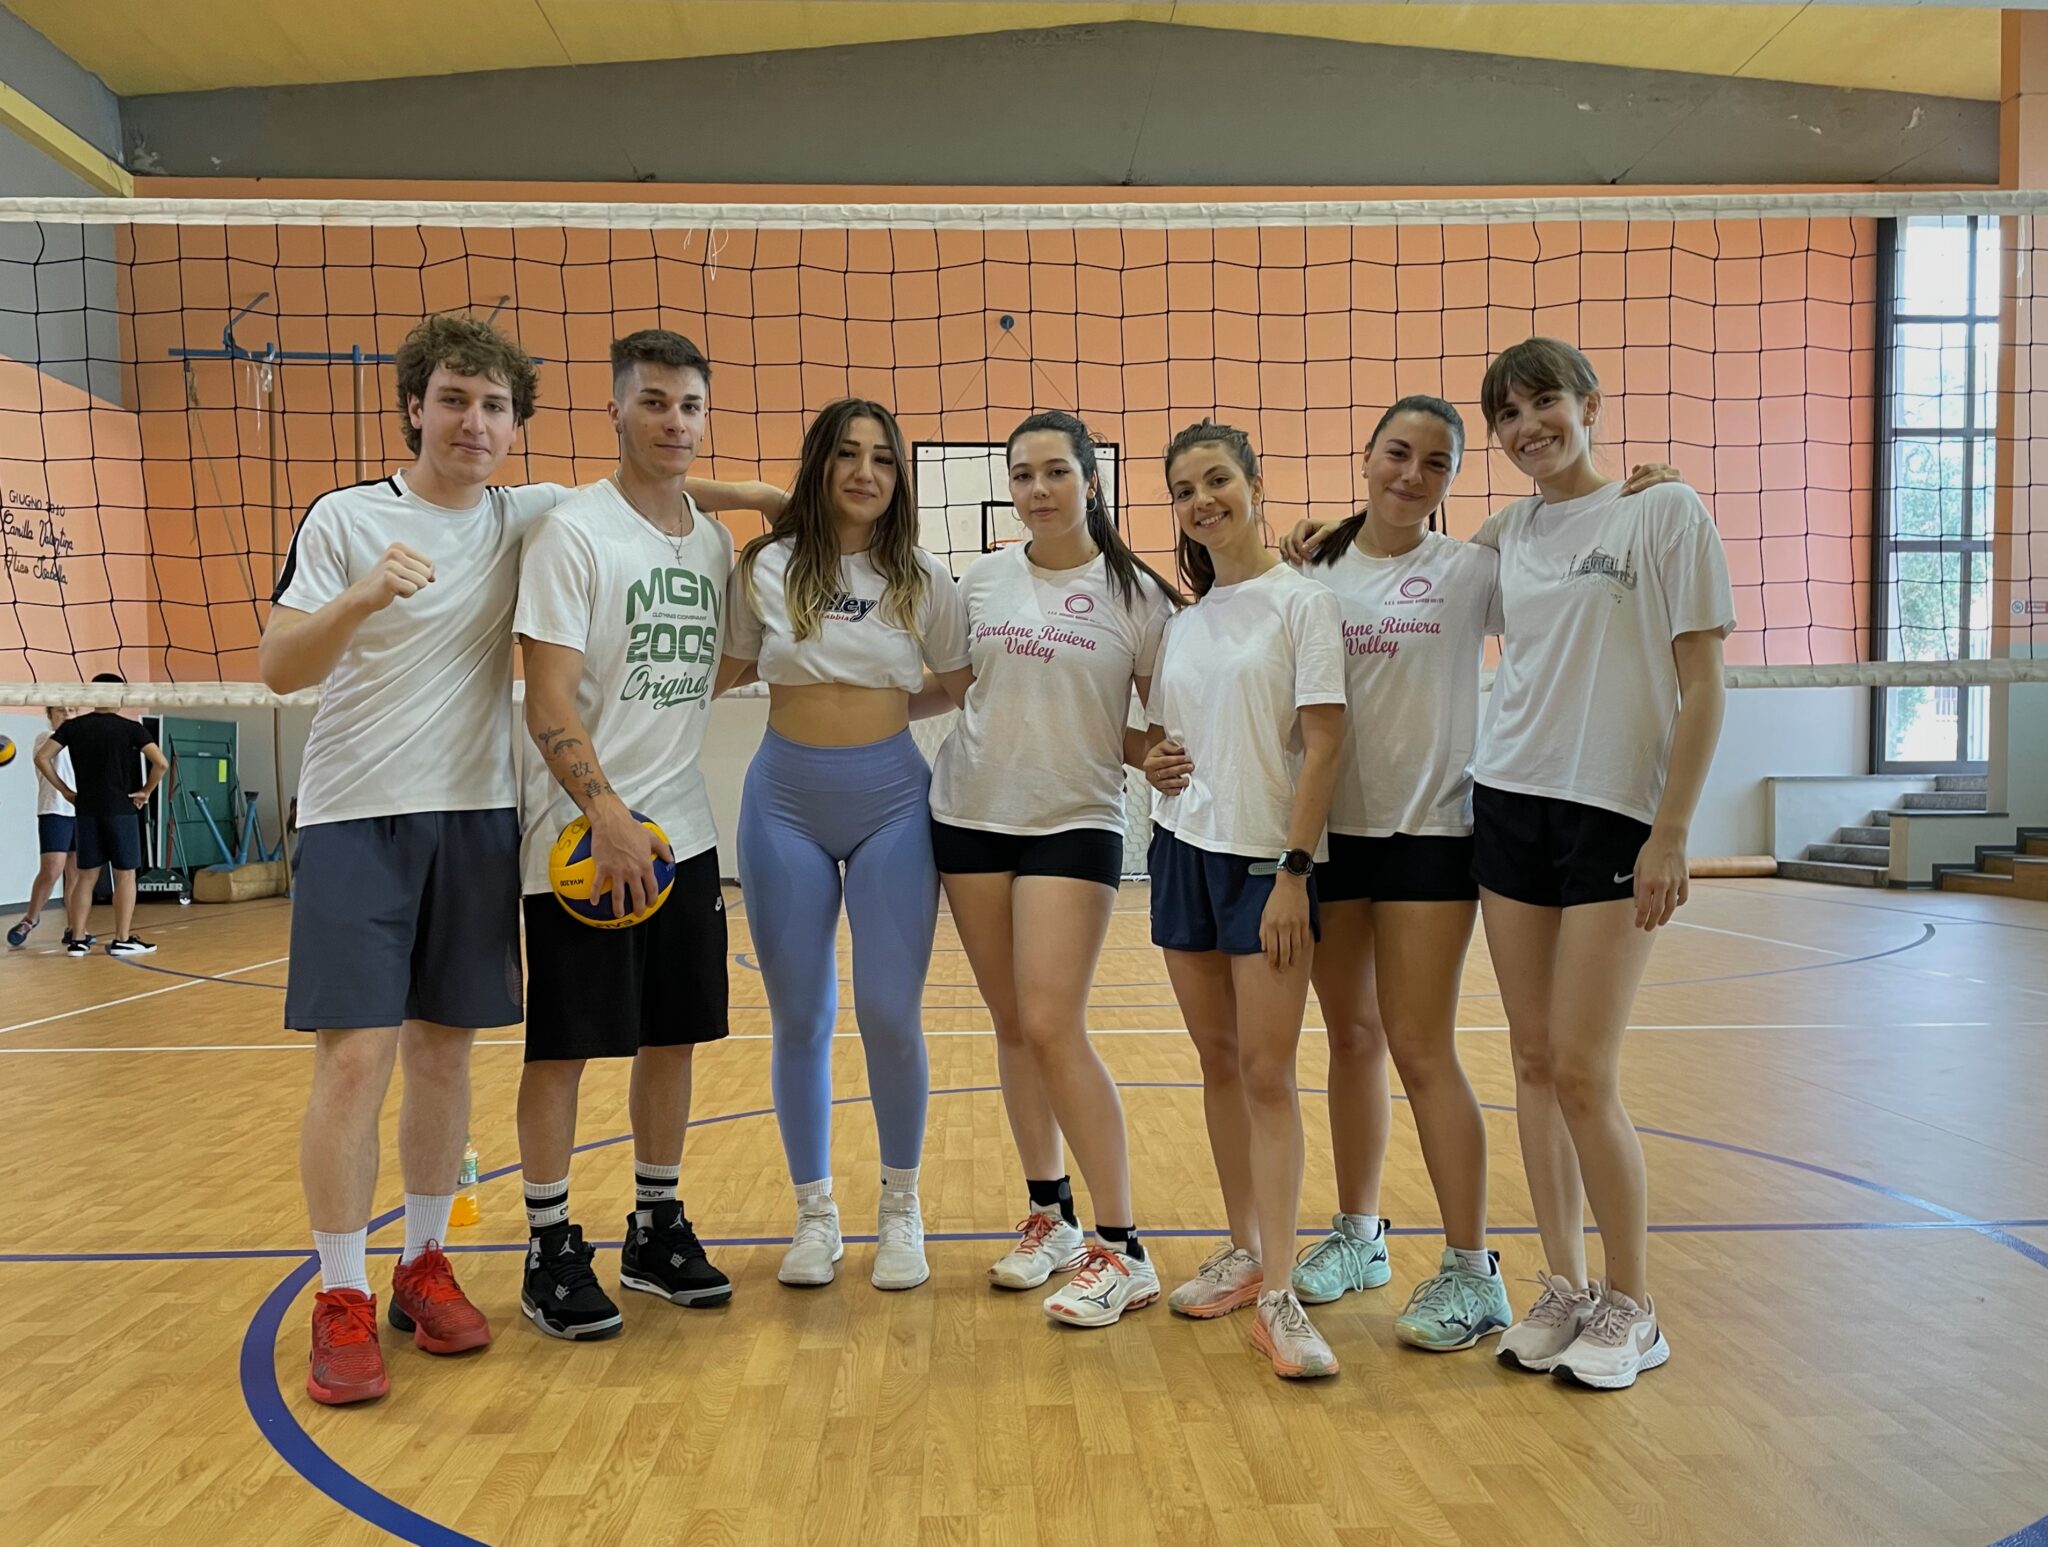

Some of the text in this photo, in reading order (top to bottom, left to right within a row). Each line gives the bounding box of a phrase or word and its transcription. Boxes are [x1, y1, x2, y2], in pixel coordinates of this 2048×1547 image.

[9, 490, 42, 508] GIUGNO
[976, 620, 1097, 651] Gardone Riviera
[1379, 616, 1441, 635] Riviera
[1005, 636, 1055, 663] Volley
[1346, 635, 1399, 658] Volley
[138, 882, 183, 891] KETTLER
